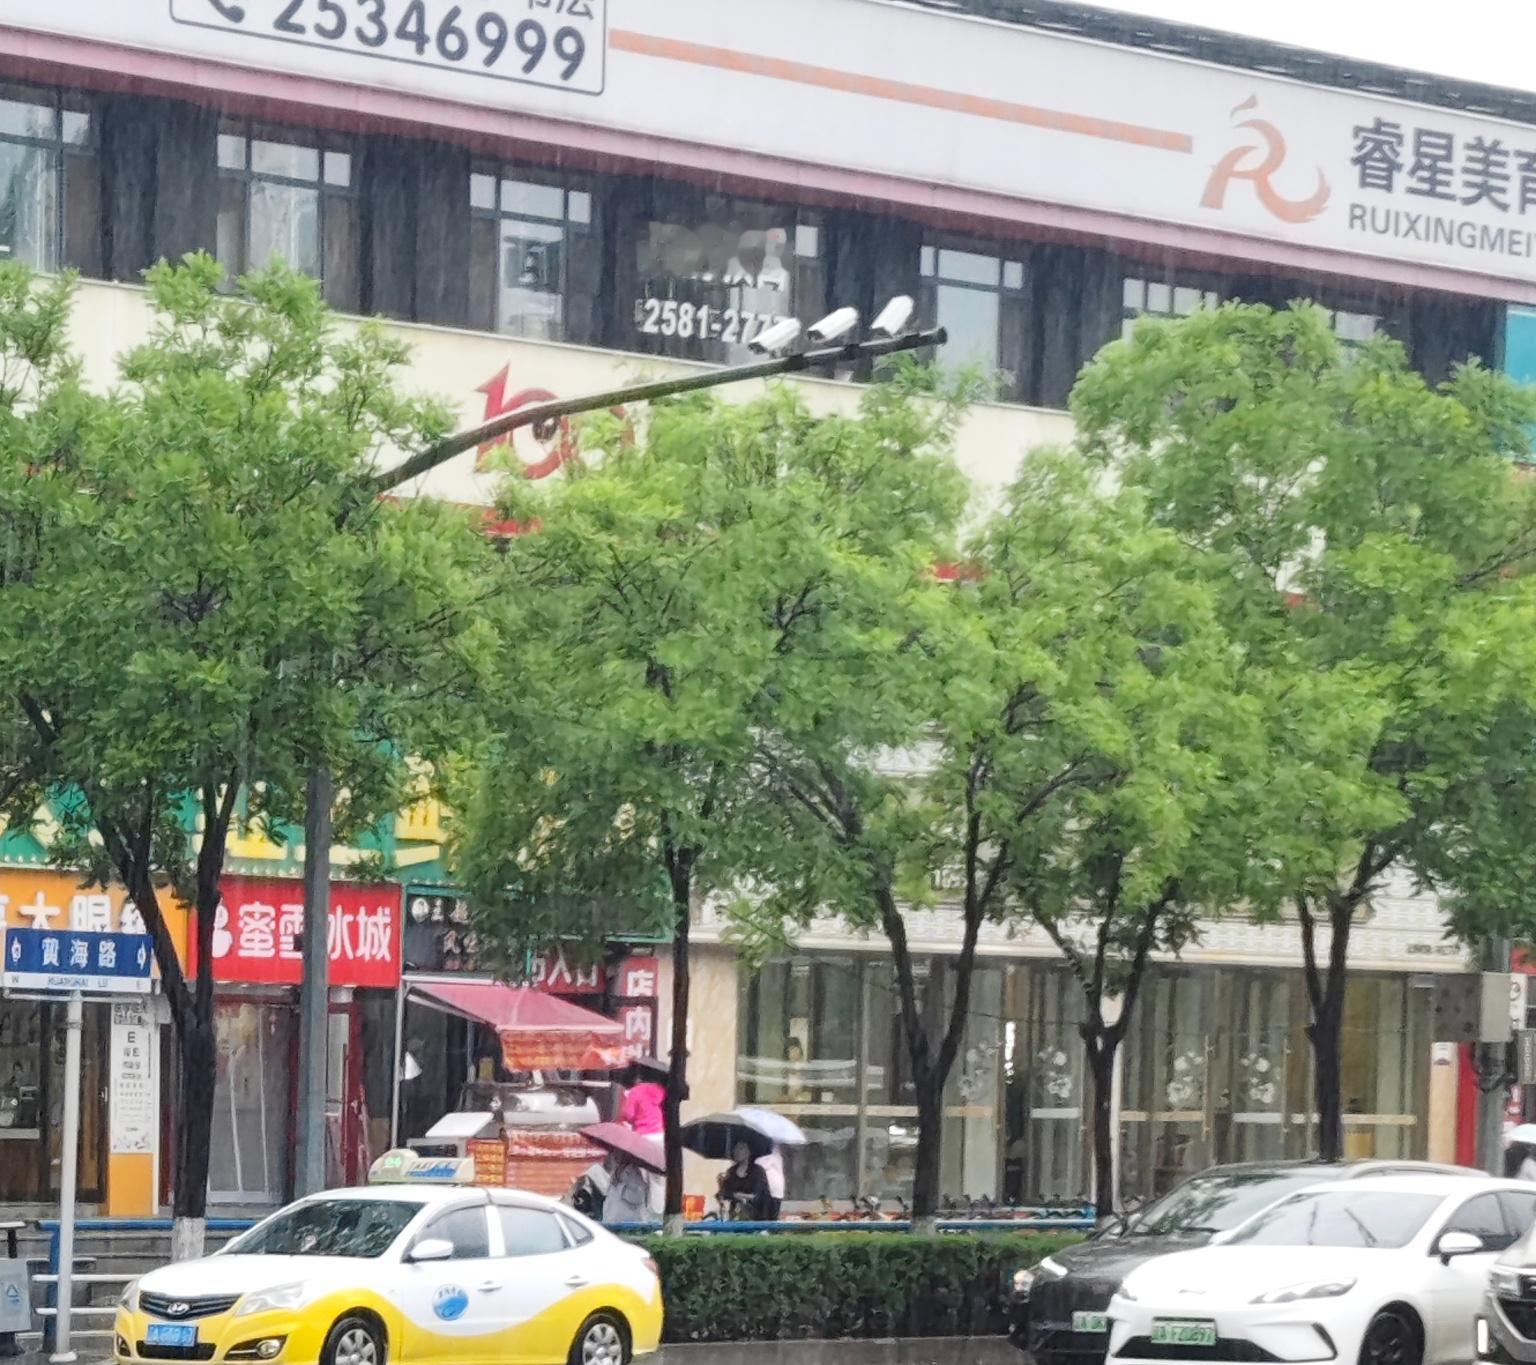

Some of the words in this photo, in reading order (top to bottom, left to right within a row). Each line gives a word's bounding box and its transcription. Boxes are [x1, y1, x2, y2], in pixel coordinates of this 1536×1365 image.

[273, 0, 586, 81] 25346999
[1348, 203, 1536, 257] RUIXINGMEI
[42, 937, 117, 968] 黄海路
